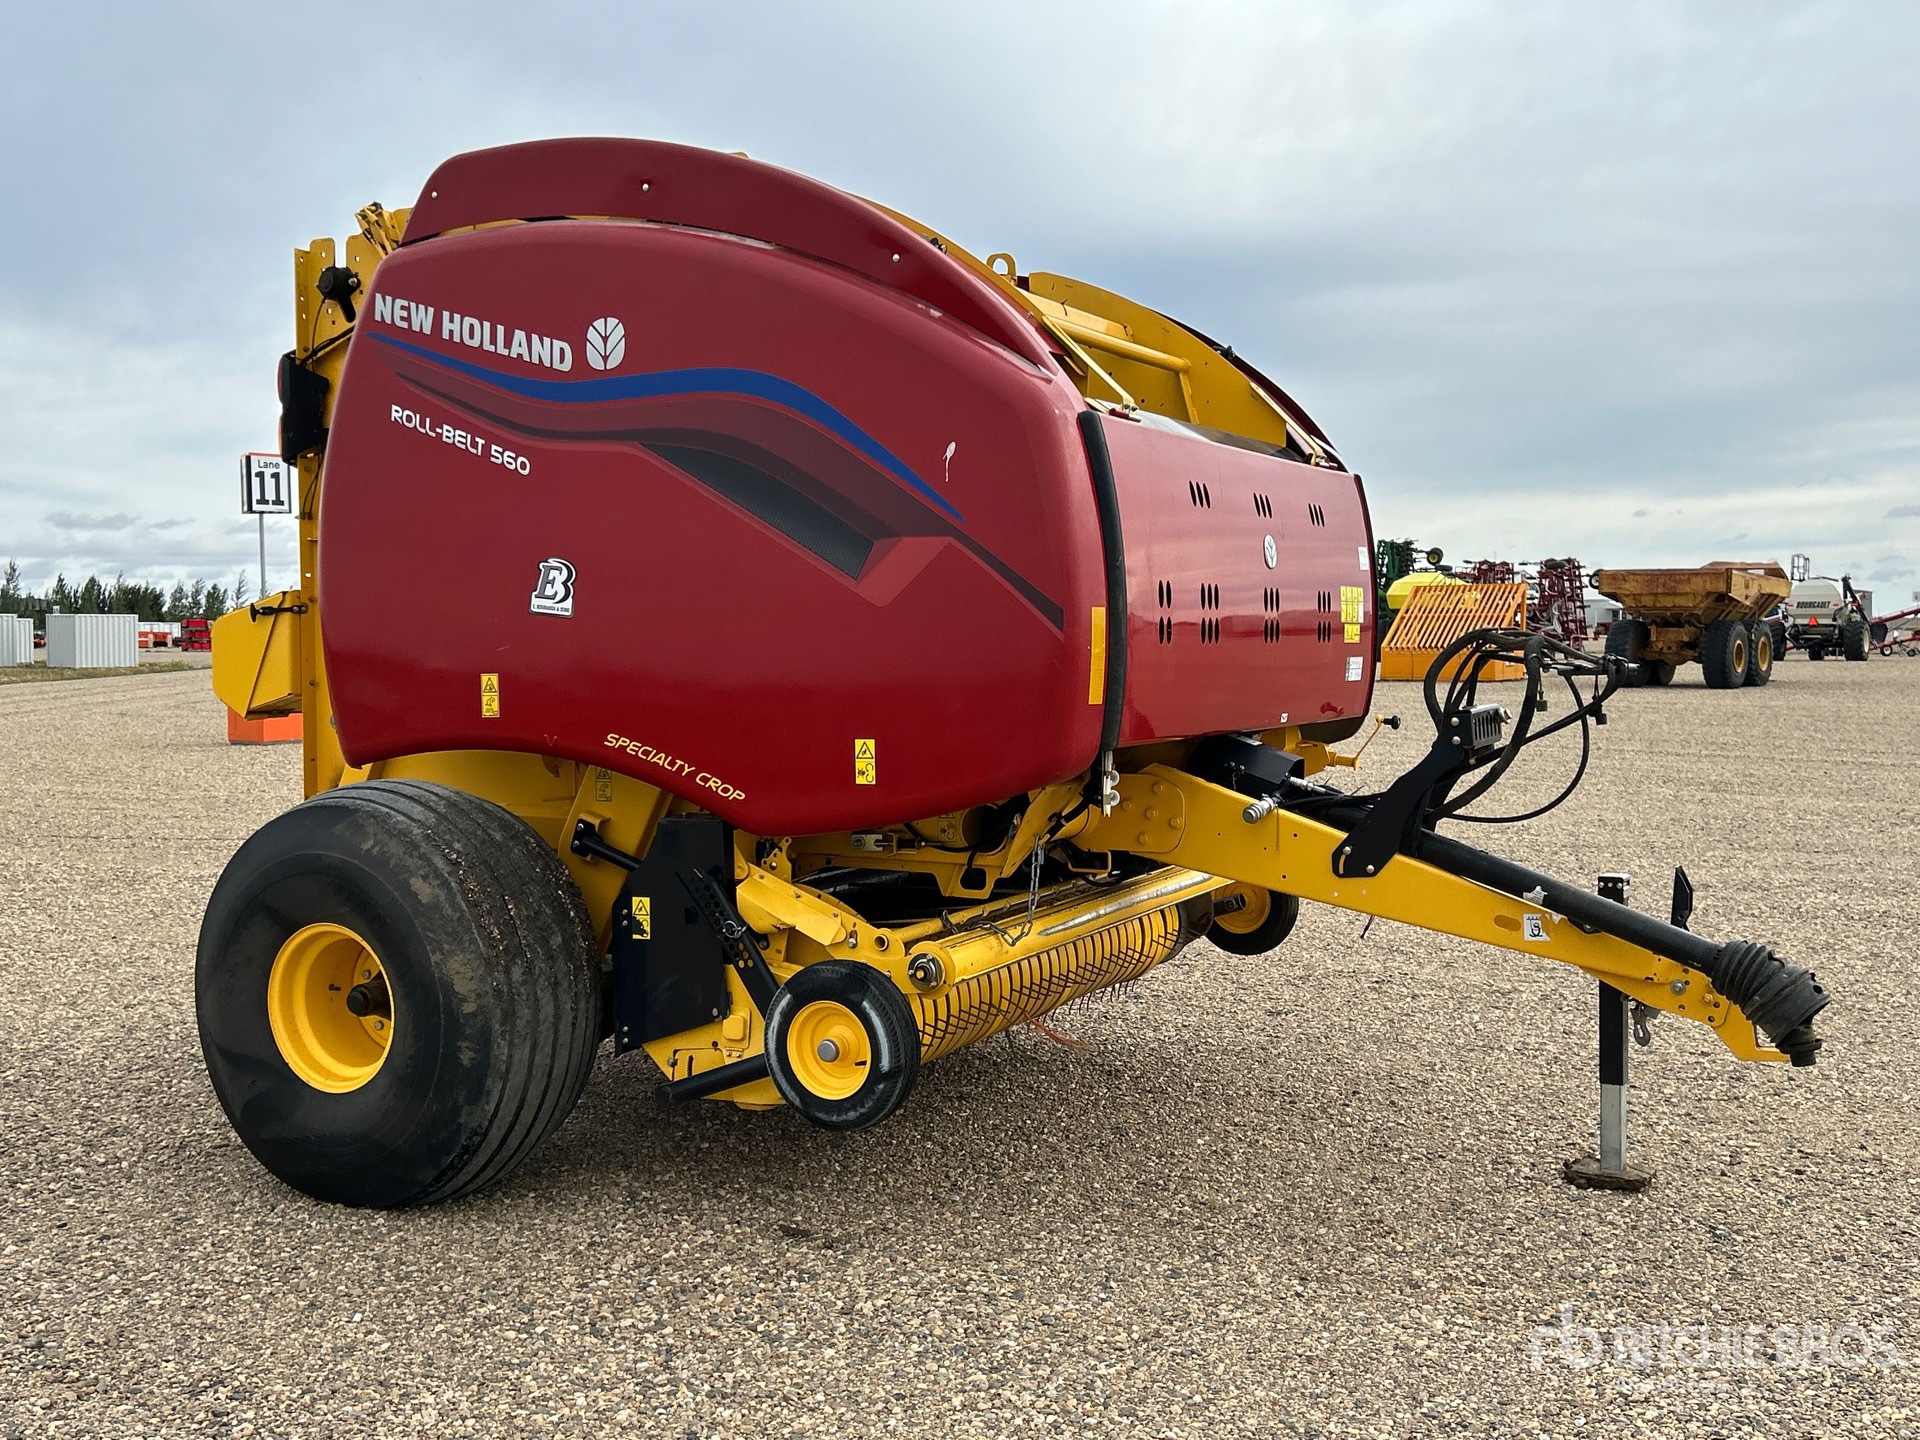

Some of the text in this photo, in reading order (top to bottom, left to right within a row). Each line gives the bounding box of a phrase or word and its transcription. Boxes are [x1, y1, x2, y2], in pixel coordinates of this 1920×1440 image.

[374, 293, 573, 372] NEW HOLLAND
[258, 459, 280, 469] Lane
[391, 404, 531, 476] ROLL-BELT 560
[254, 471, 285, 506] 11
[604, 733, 745, 800] SPECIALTY CROP
